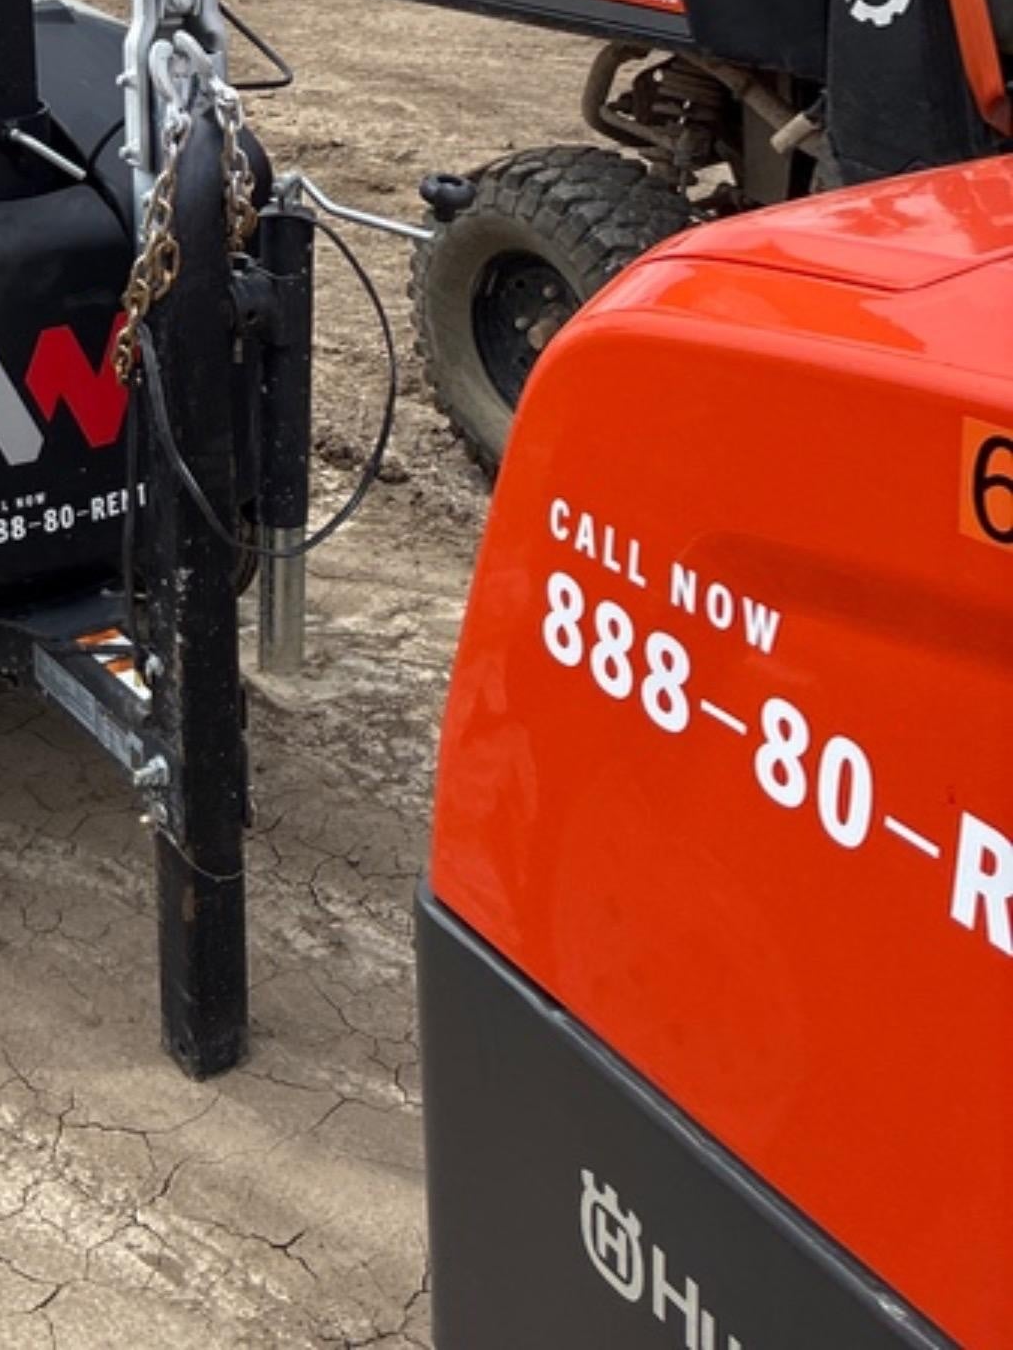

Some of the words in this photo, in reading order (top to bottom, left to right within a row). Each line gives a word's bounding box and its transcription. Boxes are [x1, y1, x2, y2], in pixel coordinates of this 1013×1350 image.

[15, 492, 47, 509] NOW
[972, 434, 1013, 545] 6
[549, 498, 647, 589] CALL
[670, 560, 781, 655] NOW
